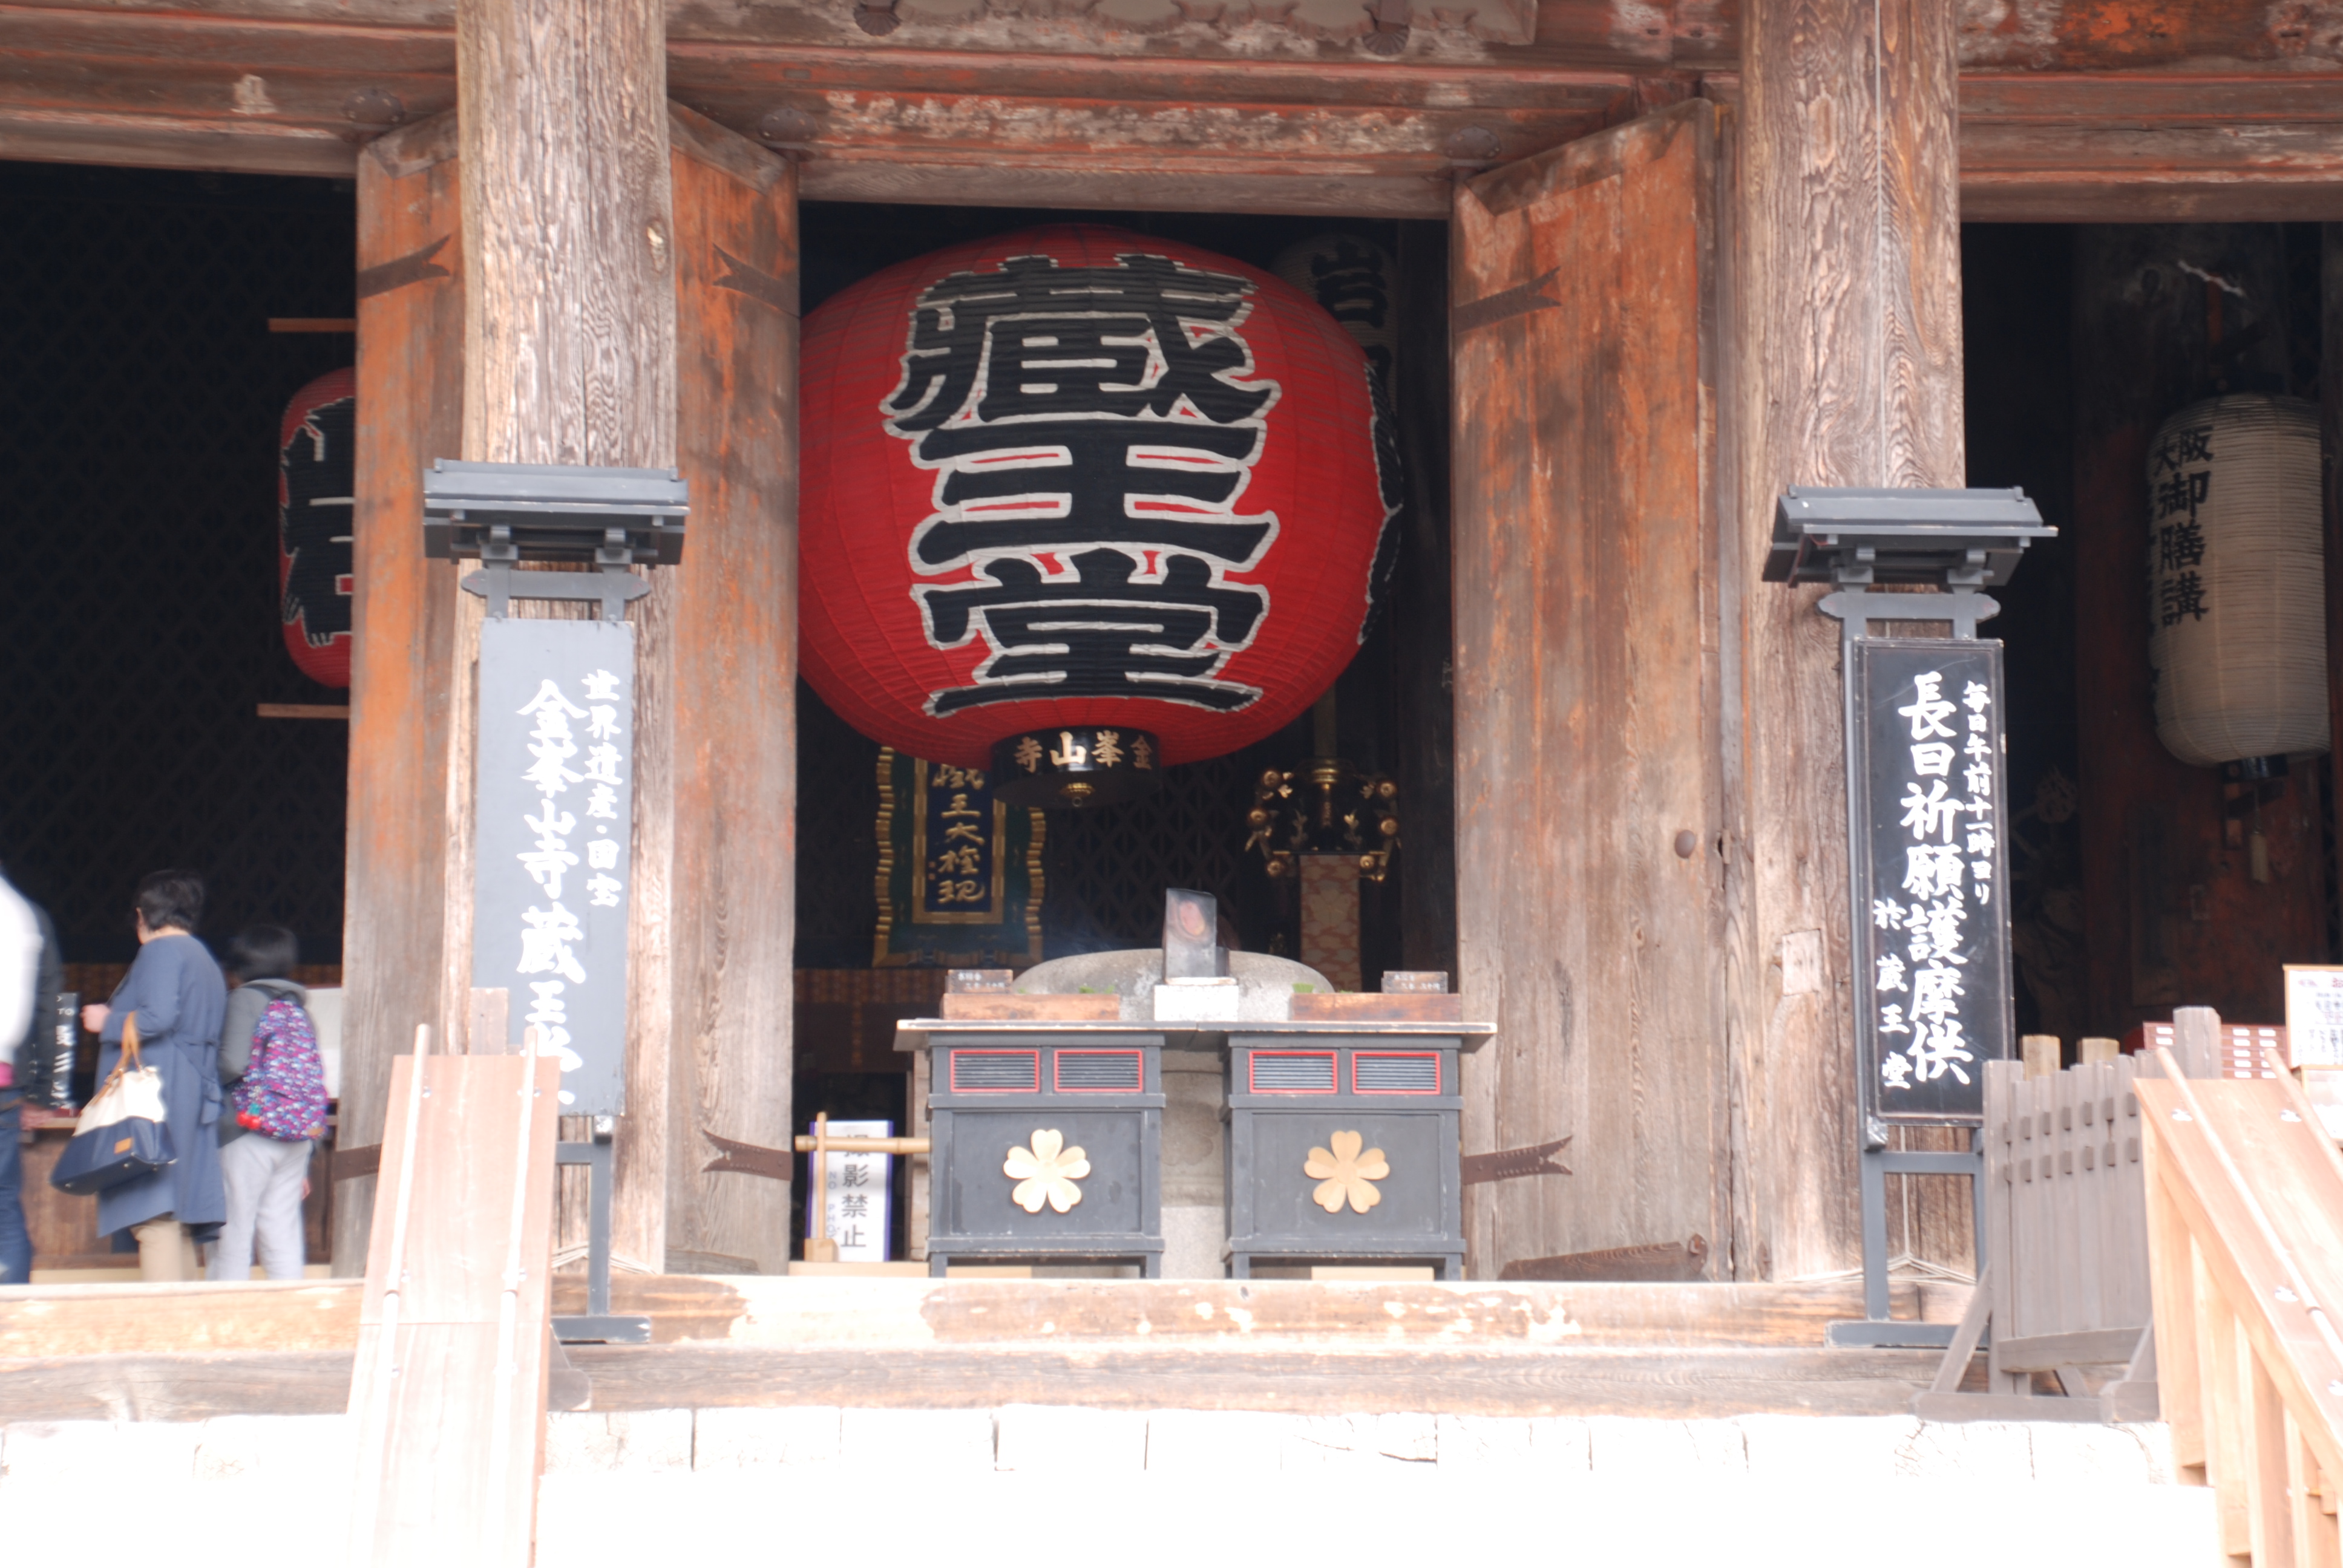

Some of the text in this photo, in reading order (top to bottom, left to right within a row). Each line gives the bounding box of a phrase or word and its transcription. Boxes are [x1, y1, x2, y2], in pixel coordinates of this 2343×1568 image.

[1897, 670, 1974, 1086] 長日祈願護摩供
